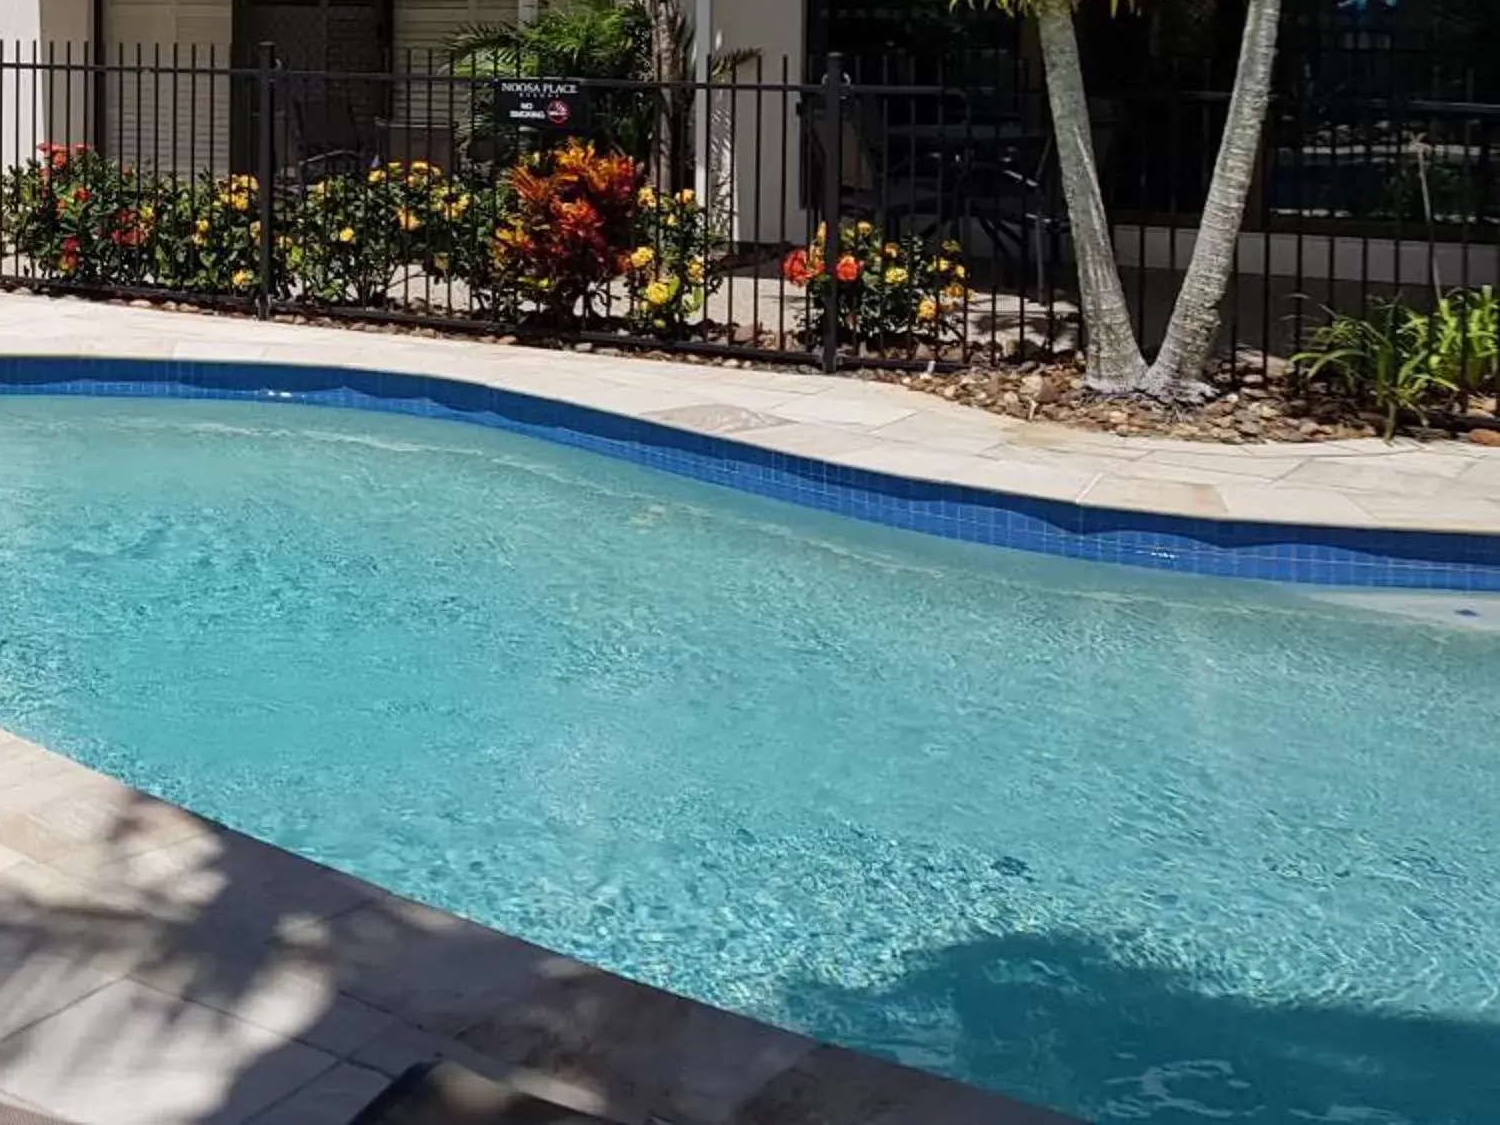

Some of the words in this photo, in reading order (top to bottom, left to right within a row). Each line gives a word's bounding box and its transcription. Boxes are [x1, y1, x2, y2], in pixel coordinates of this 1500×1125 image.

[501, 82, 541, 92] NOOSA
[543, 83, 578, 93] PLACE
[520, 102, 533, 110] NO
